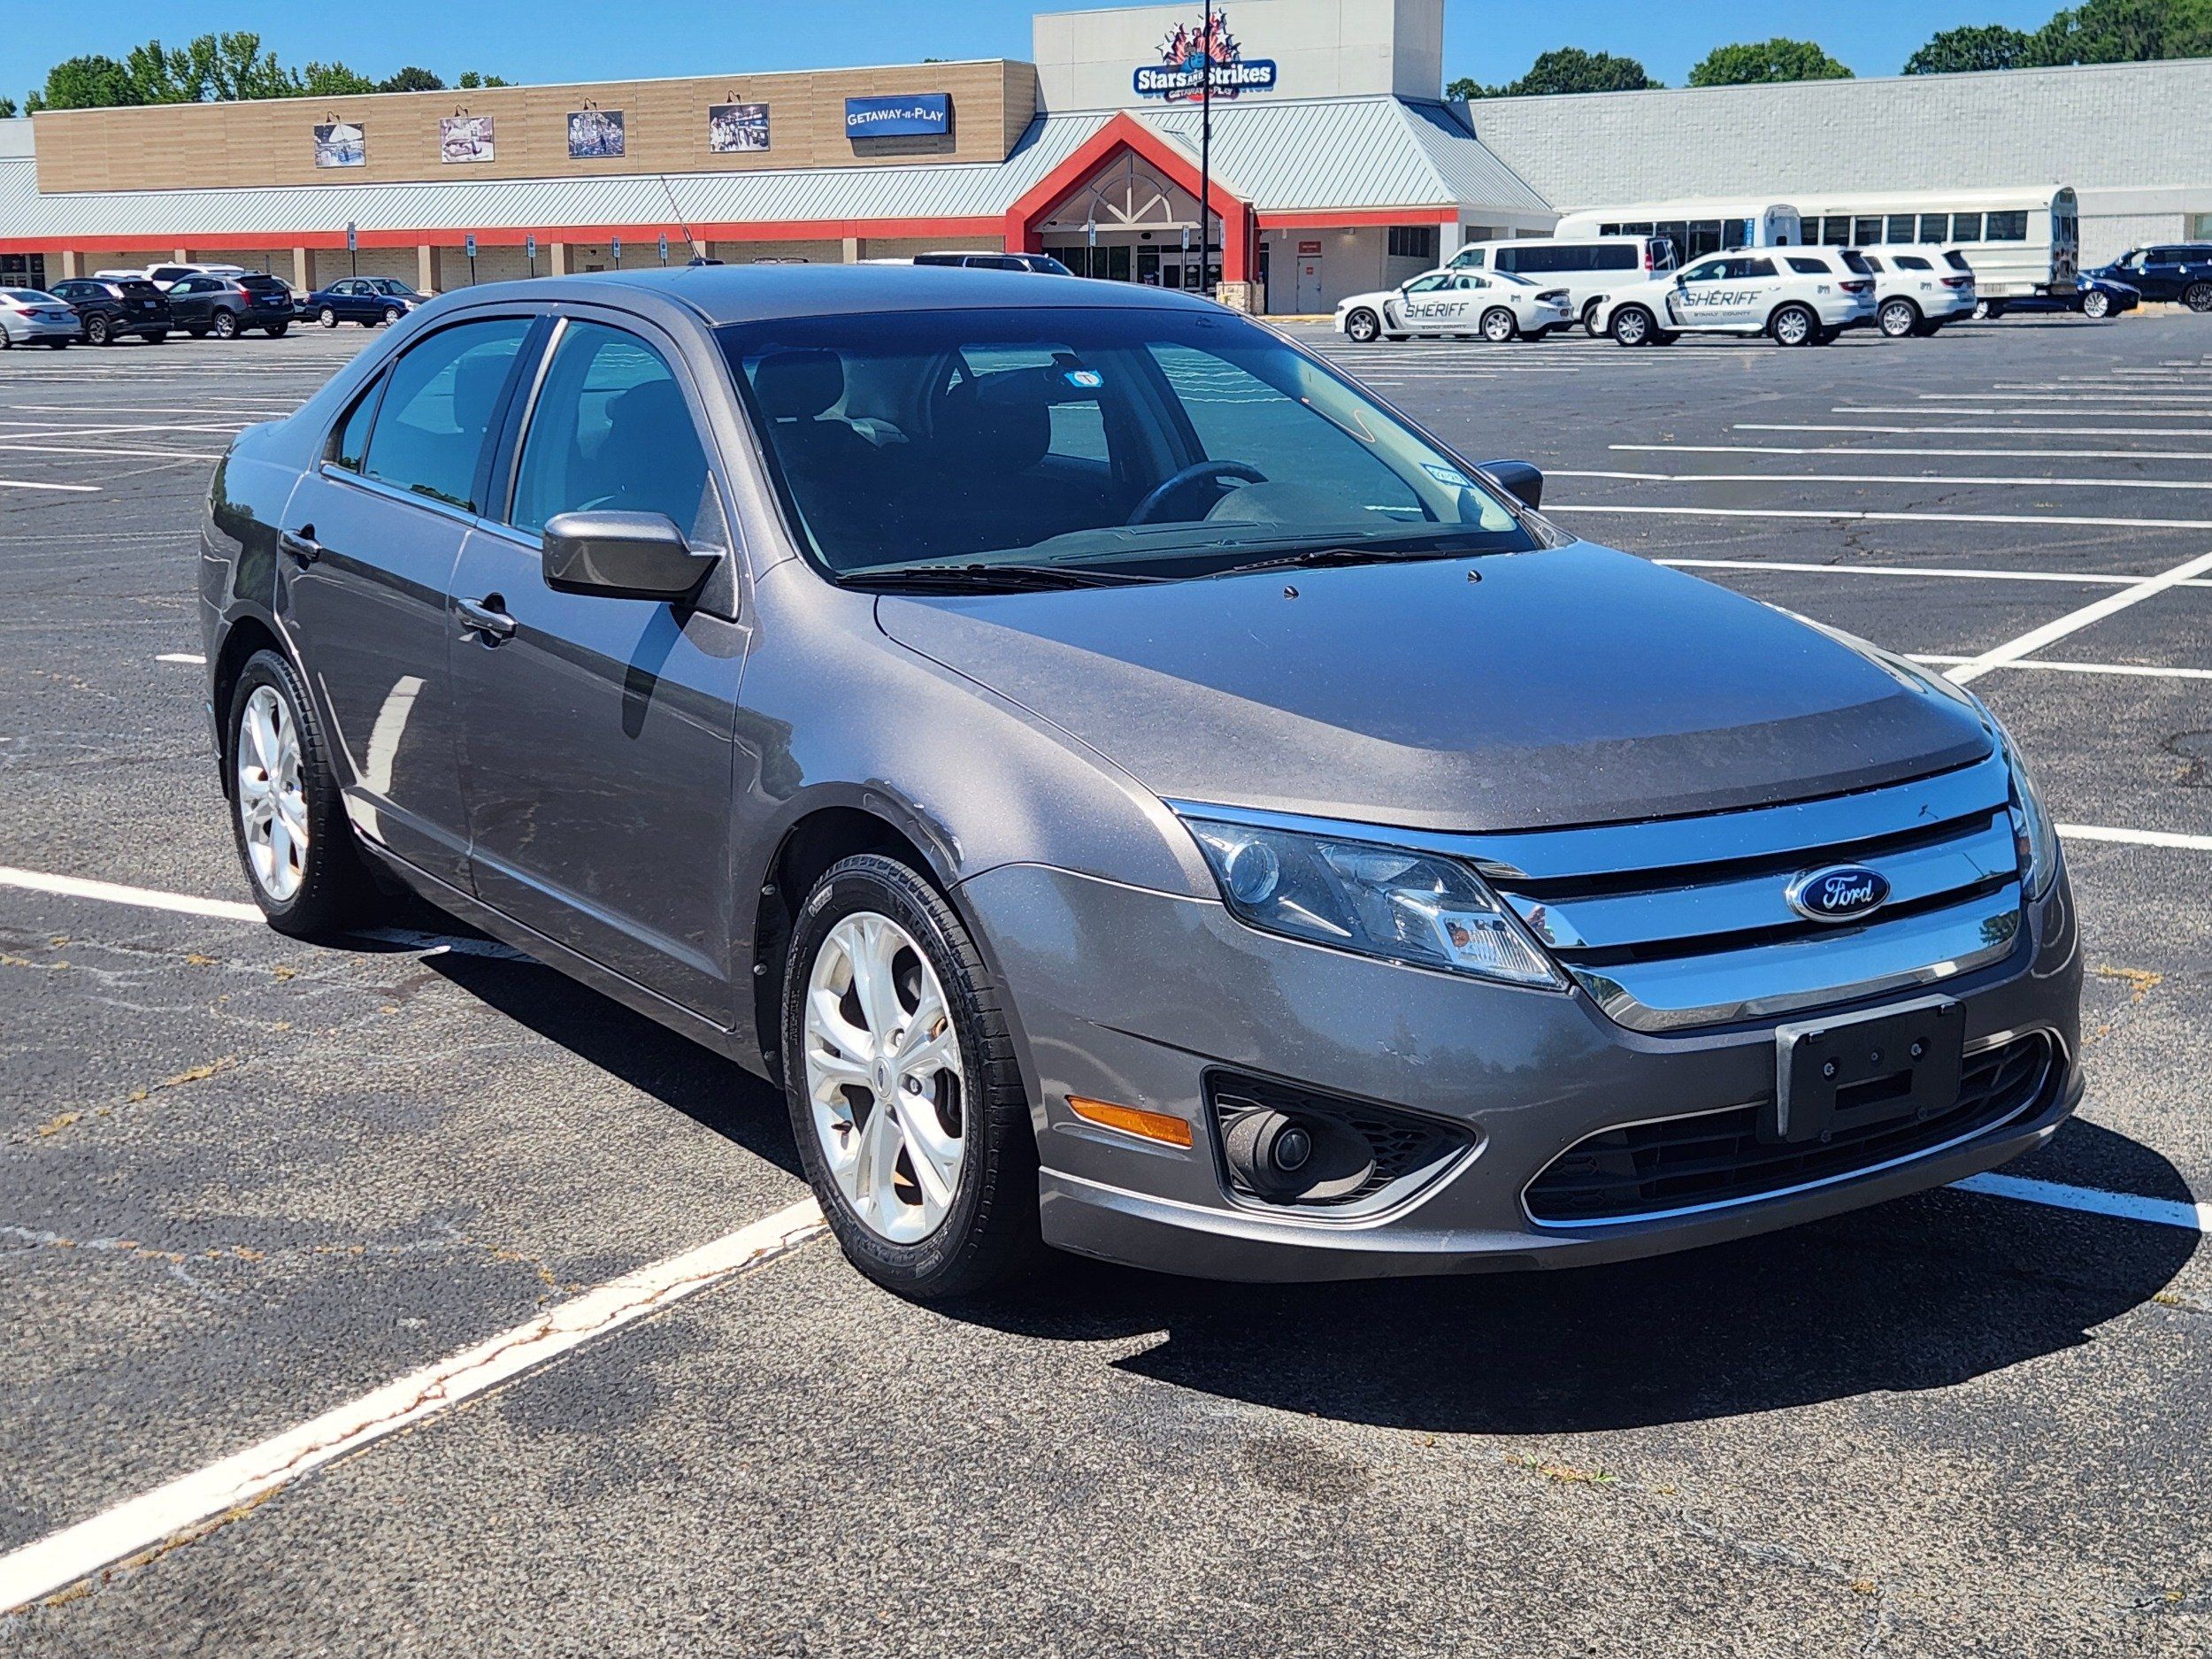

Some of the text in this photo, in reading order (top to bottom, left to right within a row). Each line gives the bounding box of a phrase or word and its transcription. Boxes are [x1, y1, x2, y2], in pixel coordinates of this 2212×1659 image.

[1138, 64, 1271, 89] Stars AND Strikes
[1683, 290, 1763, 307] SHERIFF
[1404, 302, 1470, 319] SHERIFF
[1823, 875, 1874, 909] Ford
